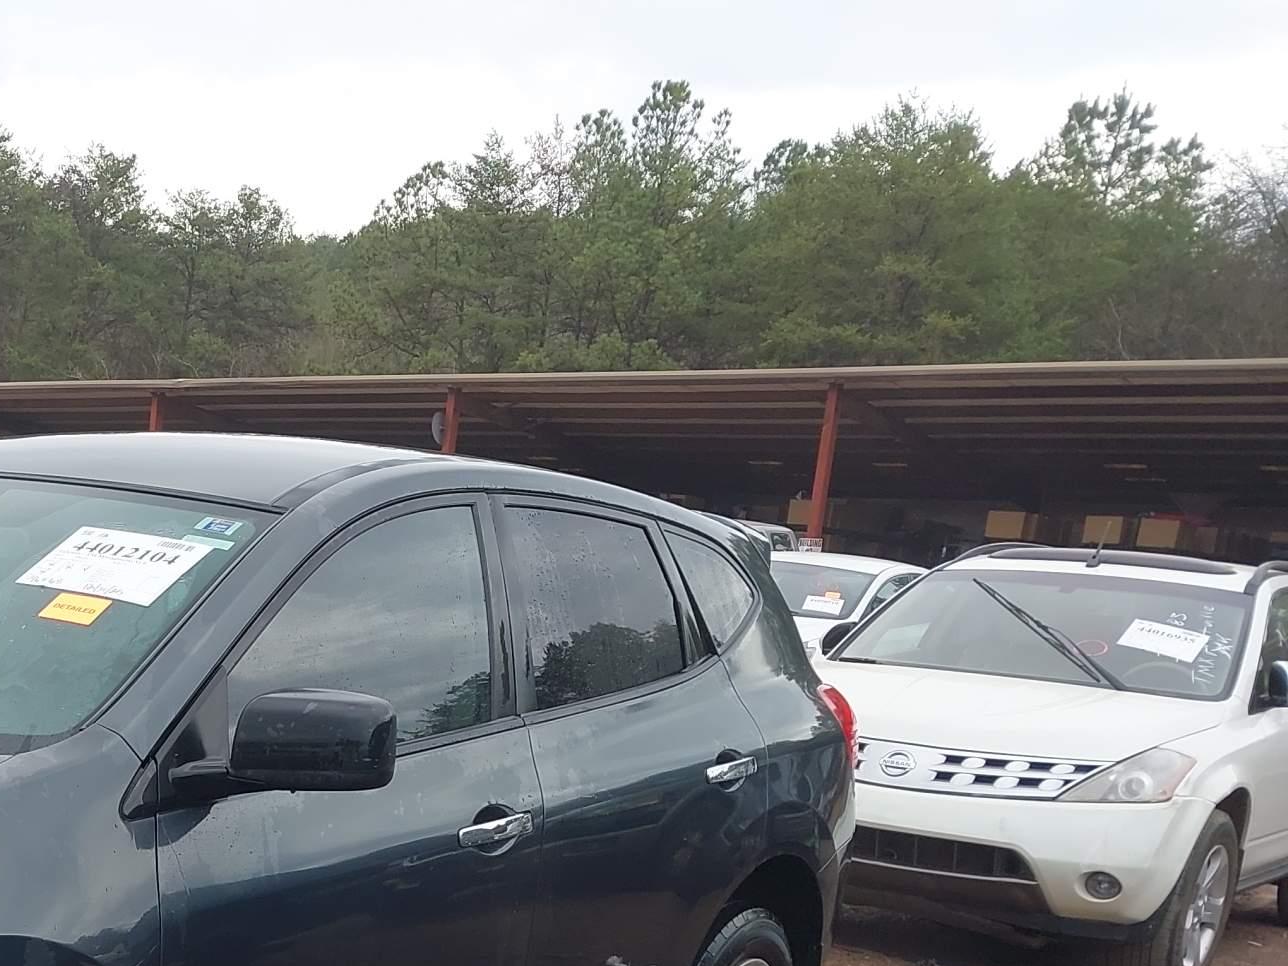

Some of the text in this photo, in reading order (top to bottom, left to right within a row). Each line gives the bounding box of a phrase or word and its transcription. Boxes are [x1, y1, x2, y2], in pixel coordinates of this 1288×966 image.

[73, 540, 181, 566] 44012104
[52, 602, 97, 615] DETAILED
[882, 759, 912, 768] NISSAN
